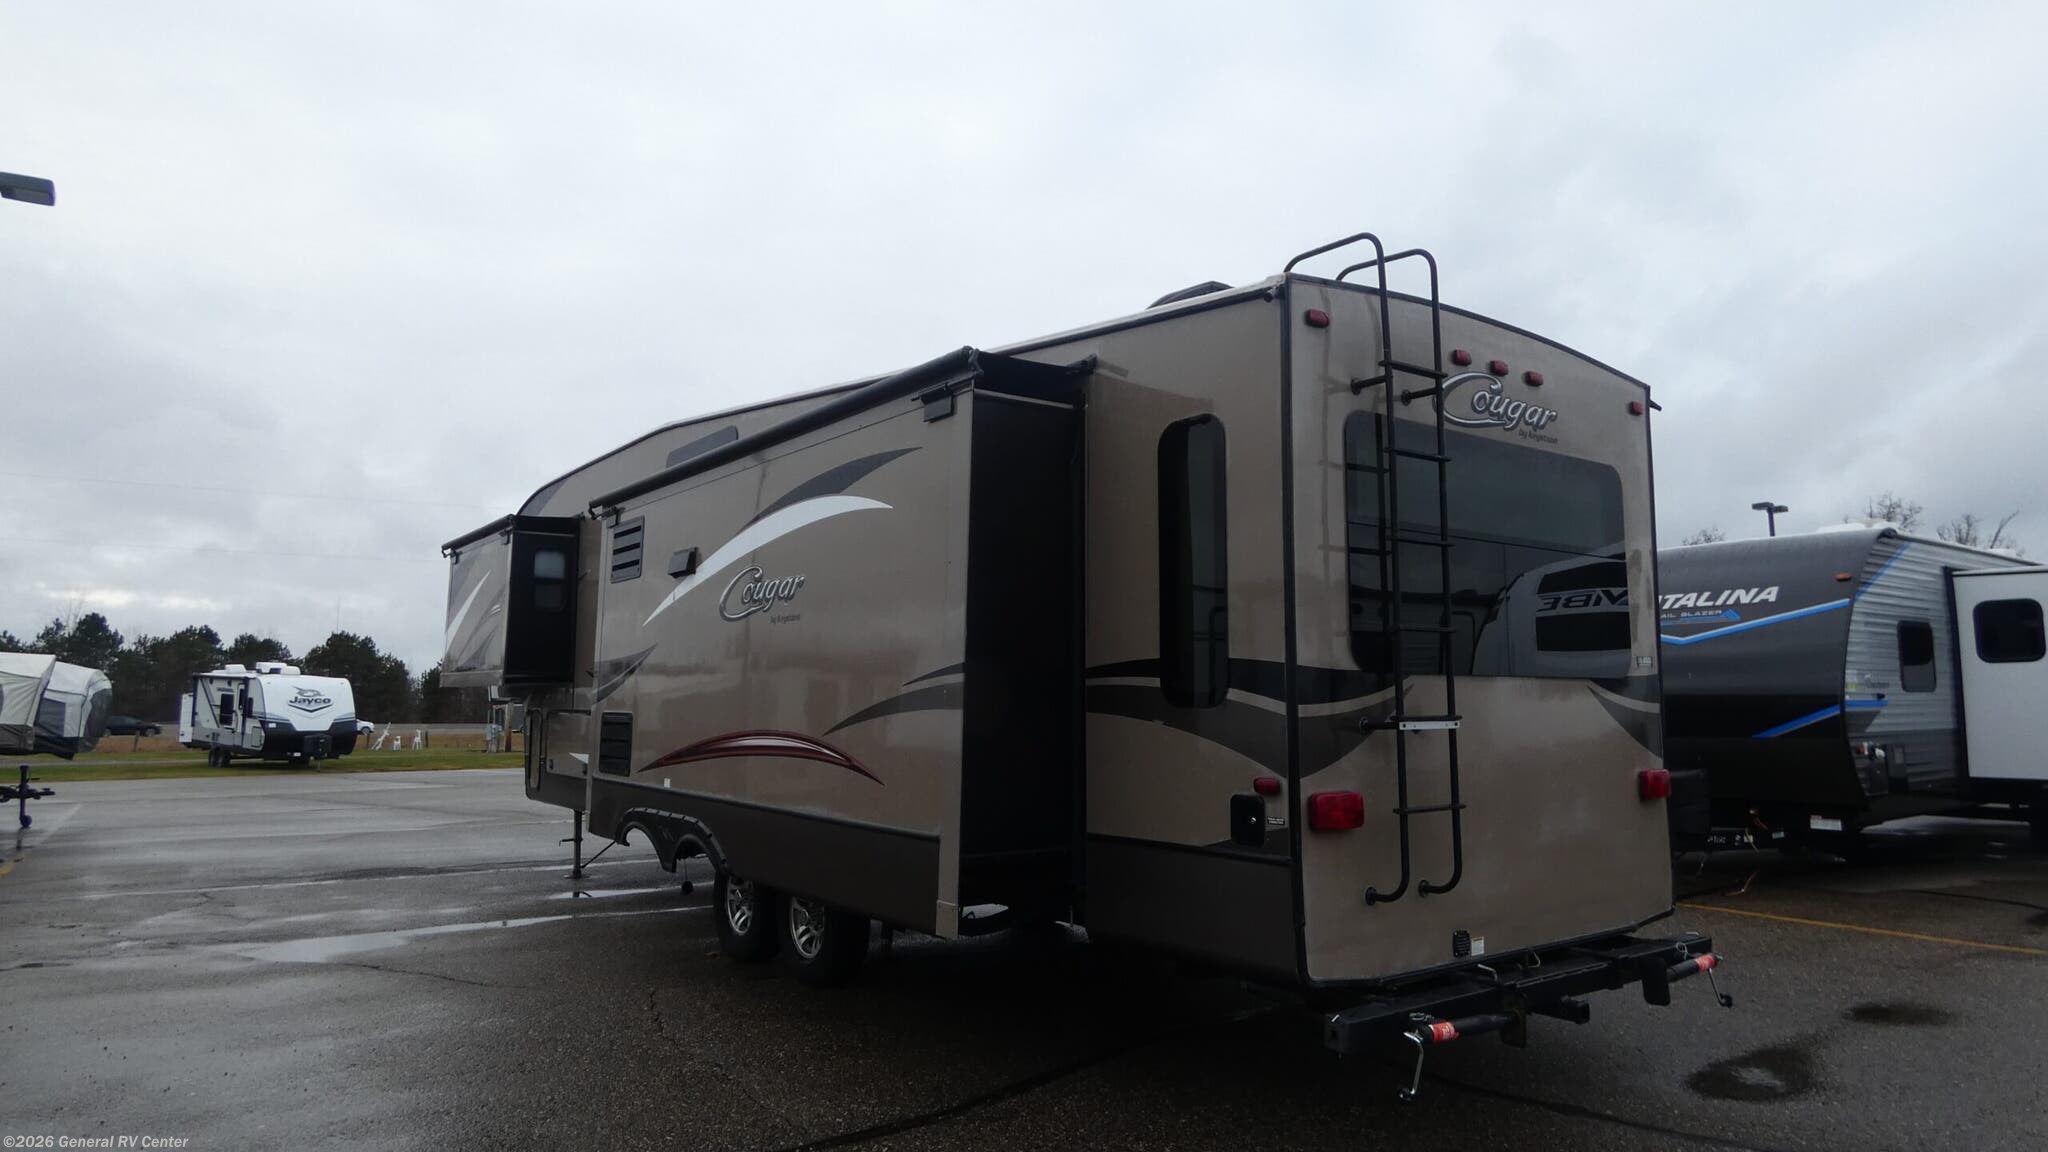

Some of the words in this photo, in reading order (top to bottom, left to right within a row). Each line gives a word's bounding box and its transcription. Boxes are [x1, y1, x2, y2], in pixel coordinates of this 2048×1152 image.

[1433, 371, 1558, 430] Cougar
[719, 566, 806, 622] Cougar
[1657, 586, 1779, 610] TALINA
[1680, 609, 1722, 618] BLAZER
[289, 696, 331, 705] Jayco
